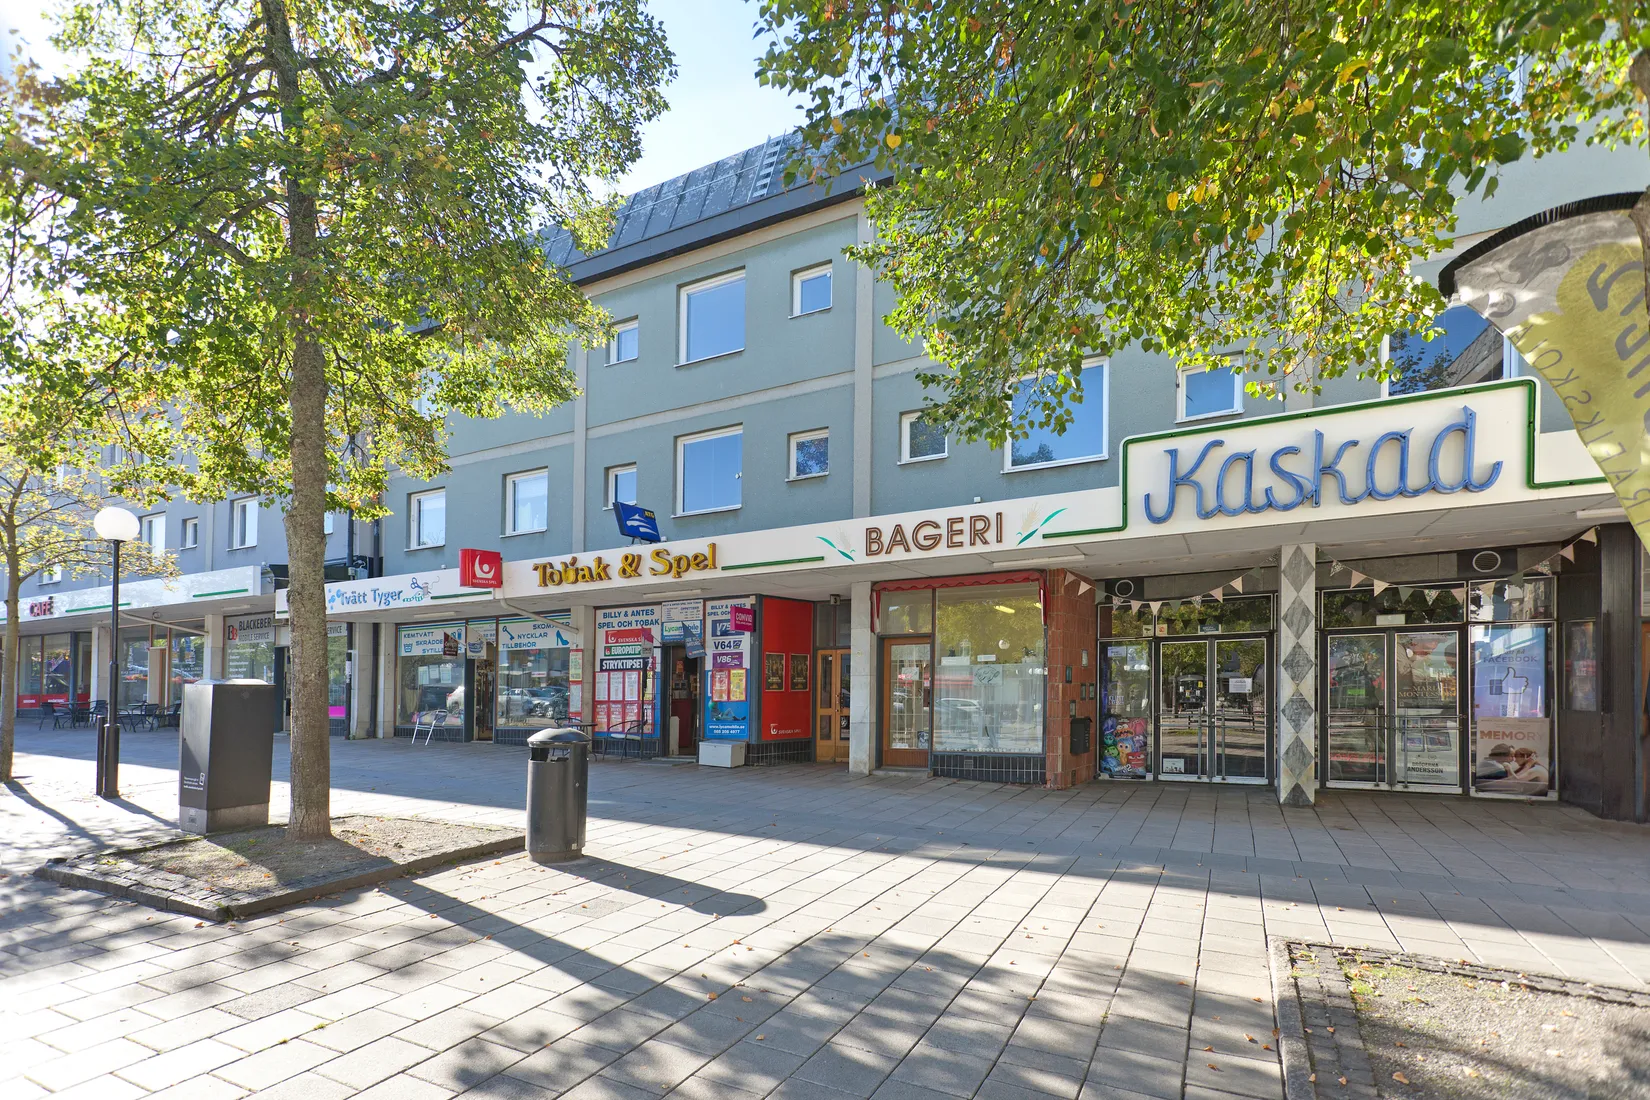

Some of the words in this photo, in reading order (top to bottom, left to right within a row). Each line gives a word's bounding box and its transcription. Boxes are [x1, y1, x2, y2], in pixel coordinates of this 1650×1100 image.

[1144, 405, 1504, 525] Kaskad
[865, 511, 1003, 557] BAGERI
[532, 556, 612, 588] Tobak
[618, 553, 642, 579] &
[649, 543, 717, 579] Spel
[341, 591, 368, 606] Tvätt
[371, 588, 404, 607] Tyger
[29, 596, 55, 617] CAFÉ
[603, 611, 622, 619] BILLY
[631, 609, 655, 617] ANTES
[239, 618, 272, 631] BLACKEBER
[598, 621, 616, 630] SPEL
[617, 620, 633, 628] OCH
[635, 619, 660, 627] TOBAK
[664, 623, 700, 633] Lycambile
[327, 626, 342, 635] ERVICE
[253, 631, 270, 641] SERVICE
[517, 632, 548, 640] NYCKLAR
[502, 641, 537, 649] TILLBEHÖR
[713, 640, 732, 650] V64
[716, 655, 732, 663] V86
[1483, 655, 1538, 663] FACEBOOK
[602, 659, 643, 670] STRYKTIPSET
[1480, 730, 1547, 741] MEMORY
[1406, 766, 1444, 774] ANDERSSON
